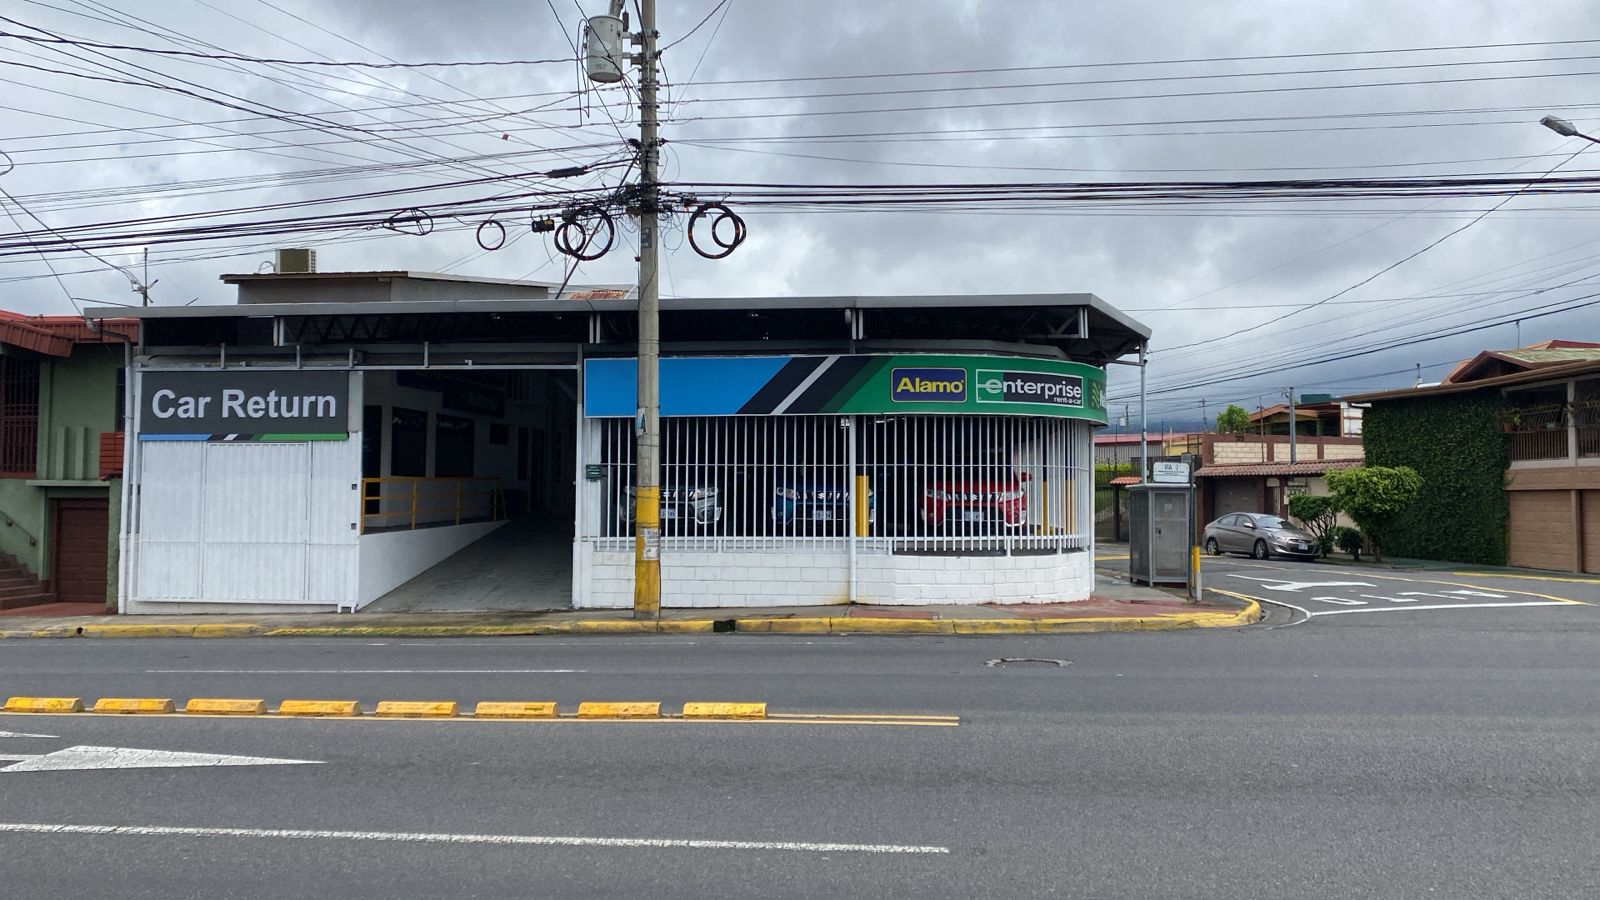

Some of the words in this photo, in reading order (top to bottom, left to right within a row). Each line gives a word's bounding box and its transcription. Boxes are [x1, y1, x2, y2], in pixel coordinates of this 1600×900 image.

[896, 377, 962, 393] Alamo
[985, 378, 1082, 399] enterprise
[152, 389, 211, 418] Car
[222, 389, 337, 418] Return
